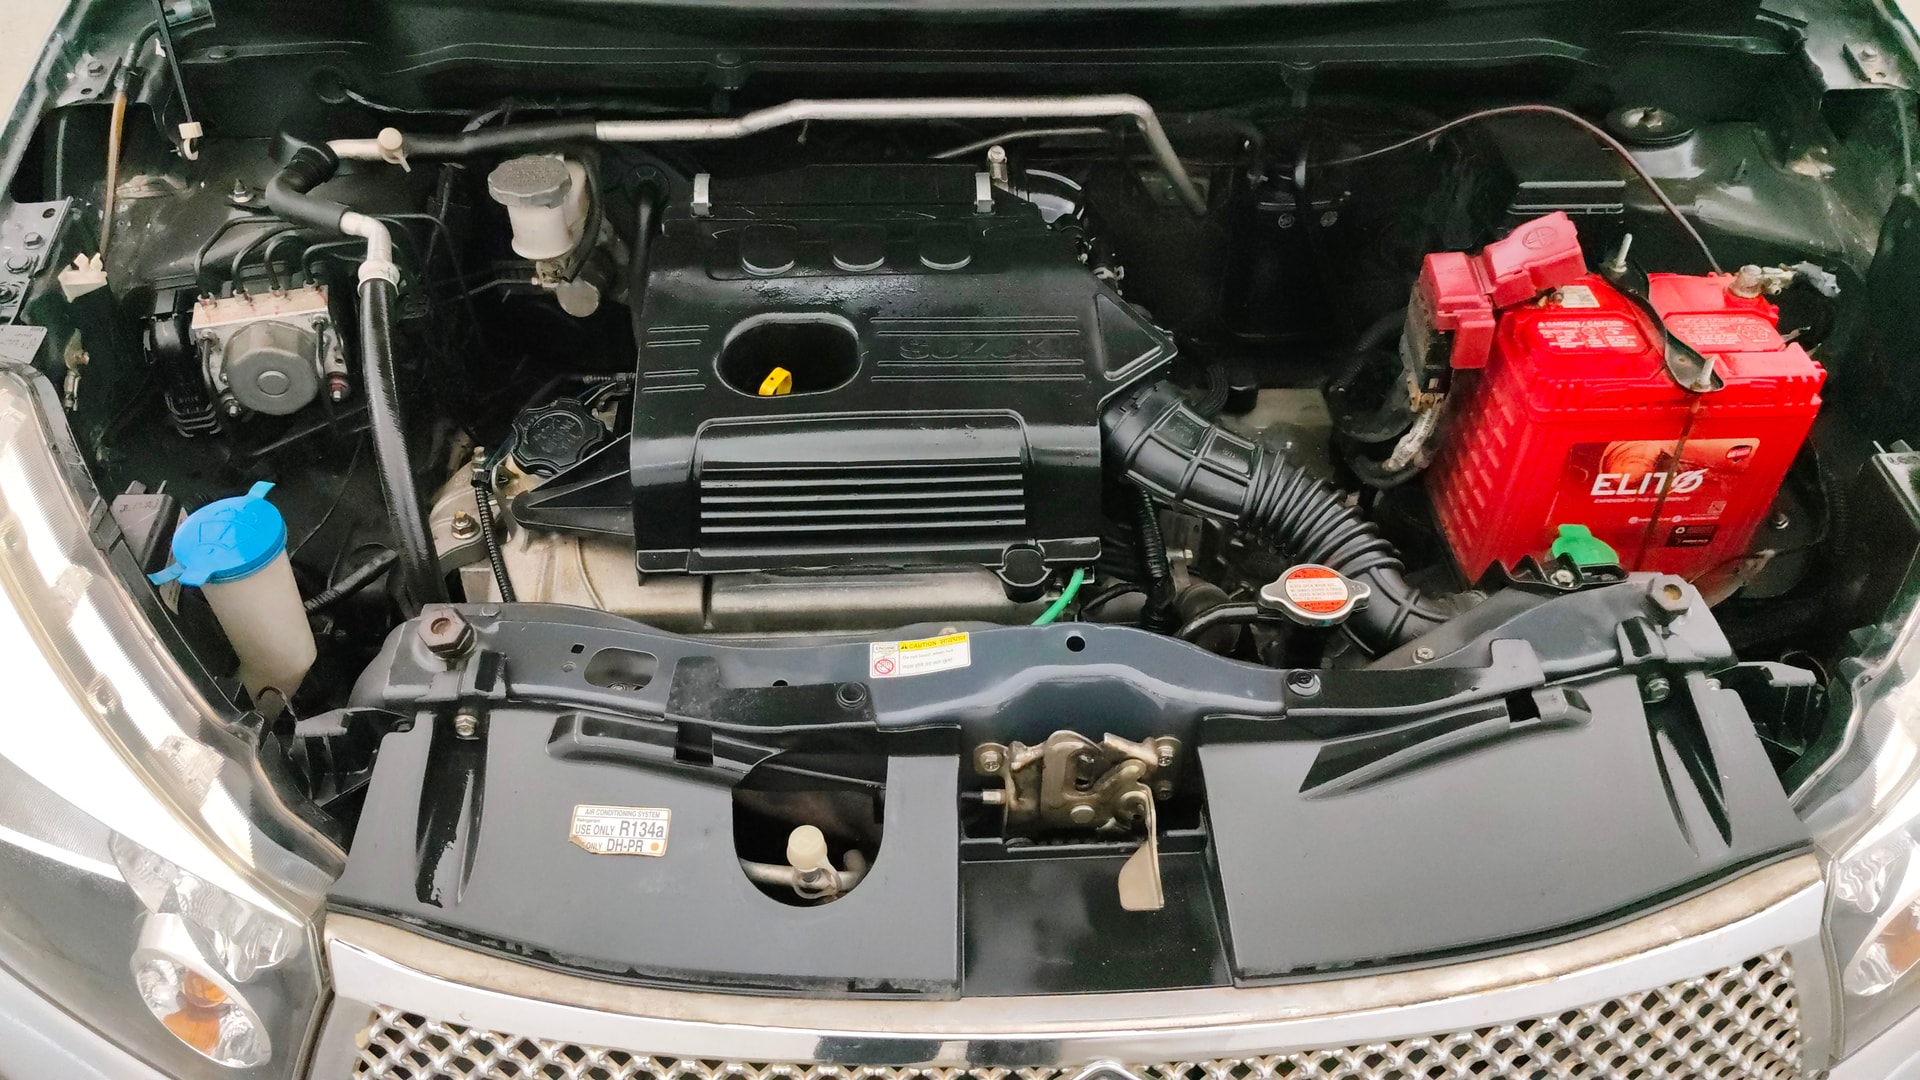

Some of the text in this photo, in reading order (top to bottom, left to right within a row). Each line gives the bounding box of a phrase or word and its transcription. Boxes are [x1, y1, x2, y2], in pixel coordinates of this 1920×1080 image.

[909, 640, 937, 650] CAUTION
[584, 808, 595, 816] AIR
[596, 809, 636, 817] CONDITIONING
[575, 820, 665, 838] USE ONLY R134a
[586, 841, 603, 851] ONLY
[606, 838, 644, 852] DH-PR
